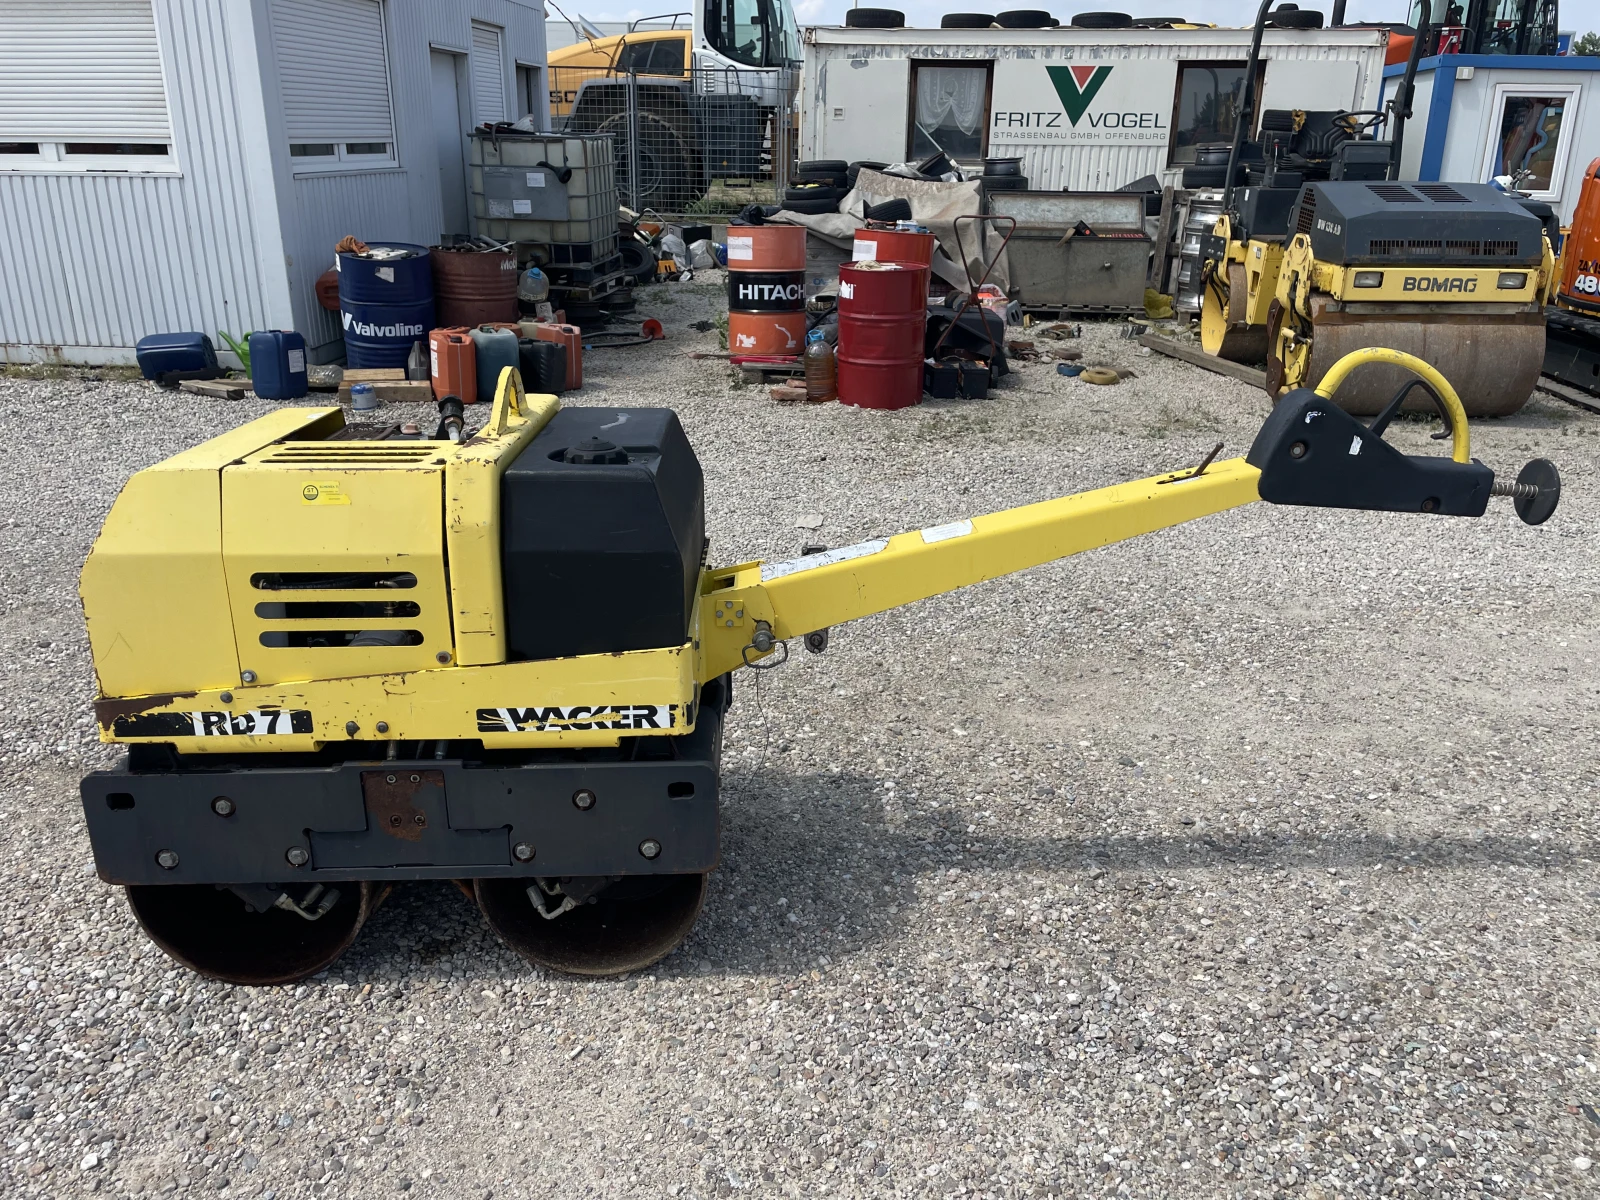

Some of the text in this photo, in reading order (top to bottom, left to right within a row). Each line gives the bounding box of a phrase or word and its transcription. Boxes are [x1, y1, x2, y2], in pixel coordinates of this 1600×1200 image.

[994, 112, 1167, 128] FRITZ VOGEL
[993, 131, 1166, 140] STRASSENBAU GMBH OFFENBURG
[1402, 276, 1478, 293] BOMAG
[1574, 274, 1600, 294] 48
[352, 320, 424, 337] Valvoline
[505, 705, 661, 731] WACKER
